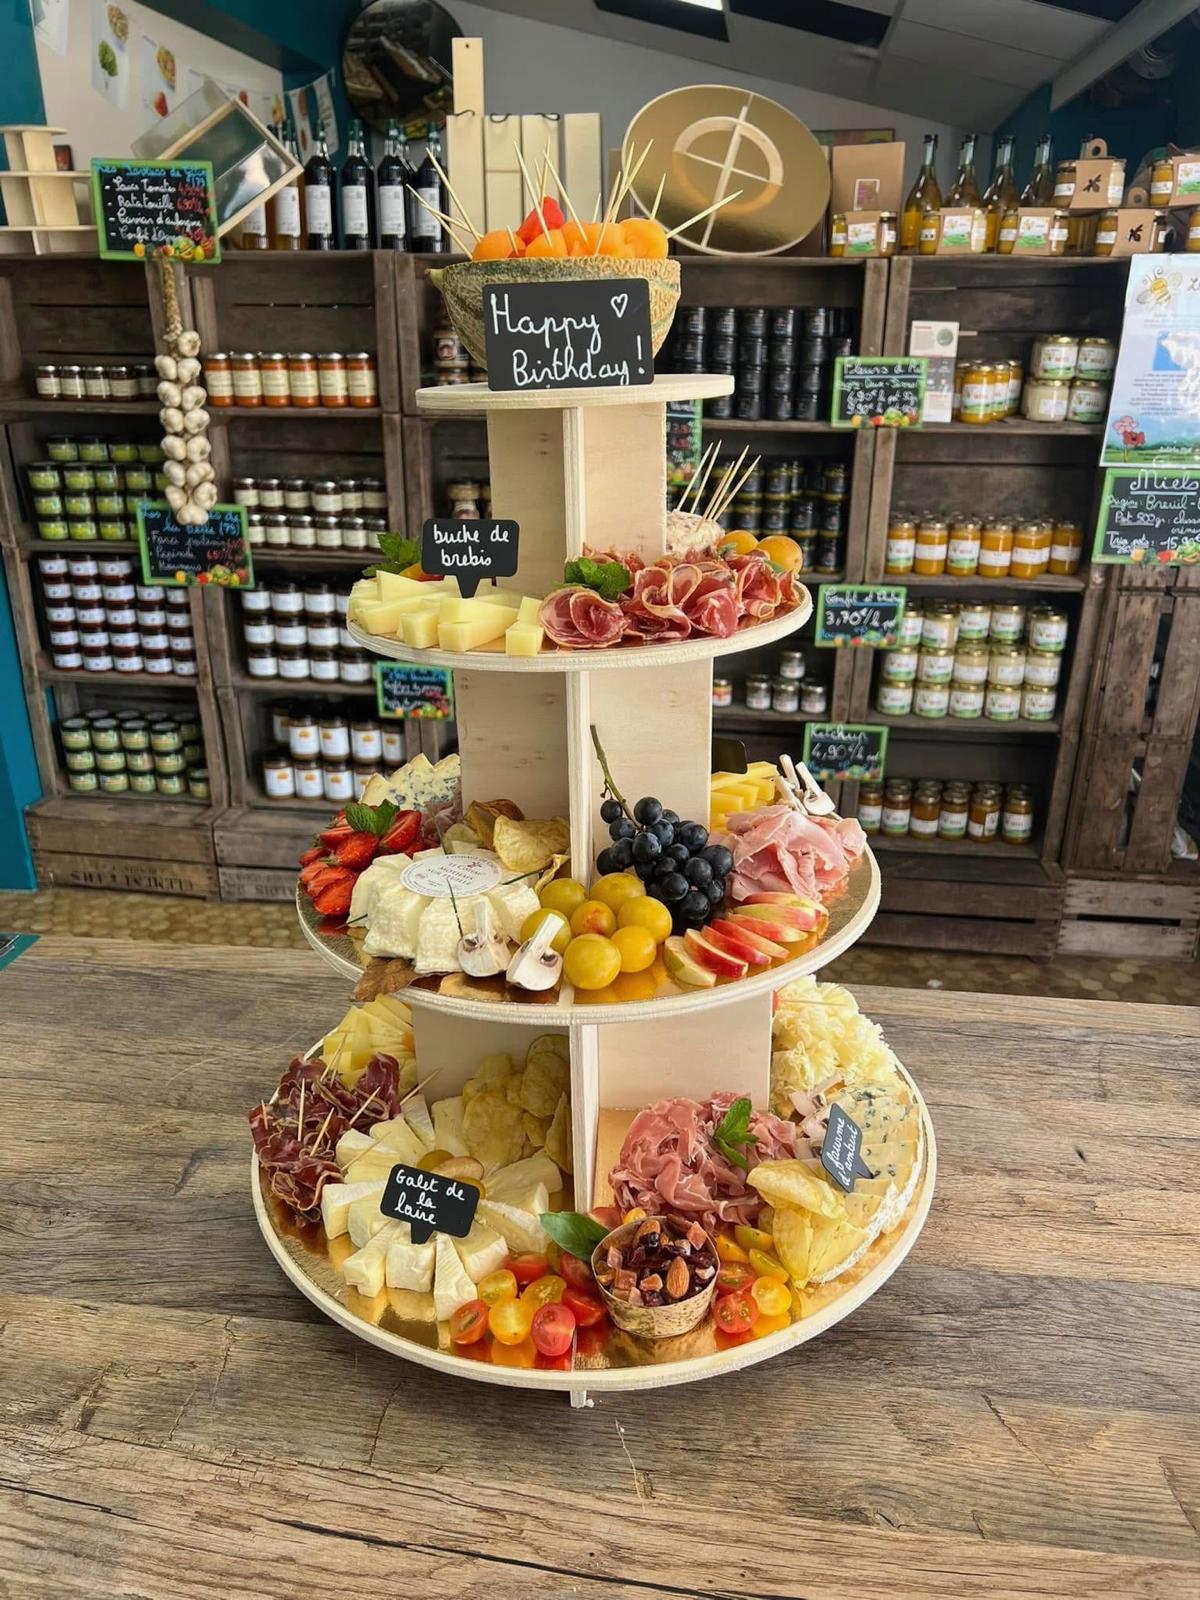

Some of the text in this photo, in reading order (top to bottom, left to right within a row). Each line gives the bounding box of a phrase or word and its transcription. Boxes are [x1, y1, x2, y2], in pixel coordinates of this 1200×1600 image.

[490, 293, 601, 354] Happy
[512, 347, 630, 386] Birthday
[1130, 469, 1199, 490] Miels
[1146, 495, 1188, 510] Breuil
[433, 523, 509, 544] buche de
[395, 1168, 466, 1201] Galet de
